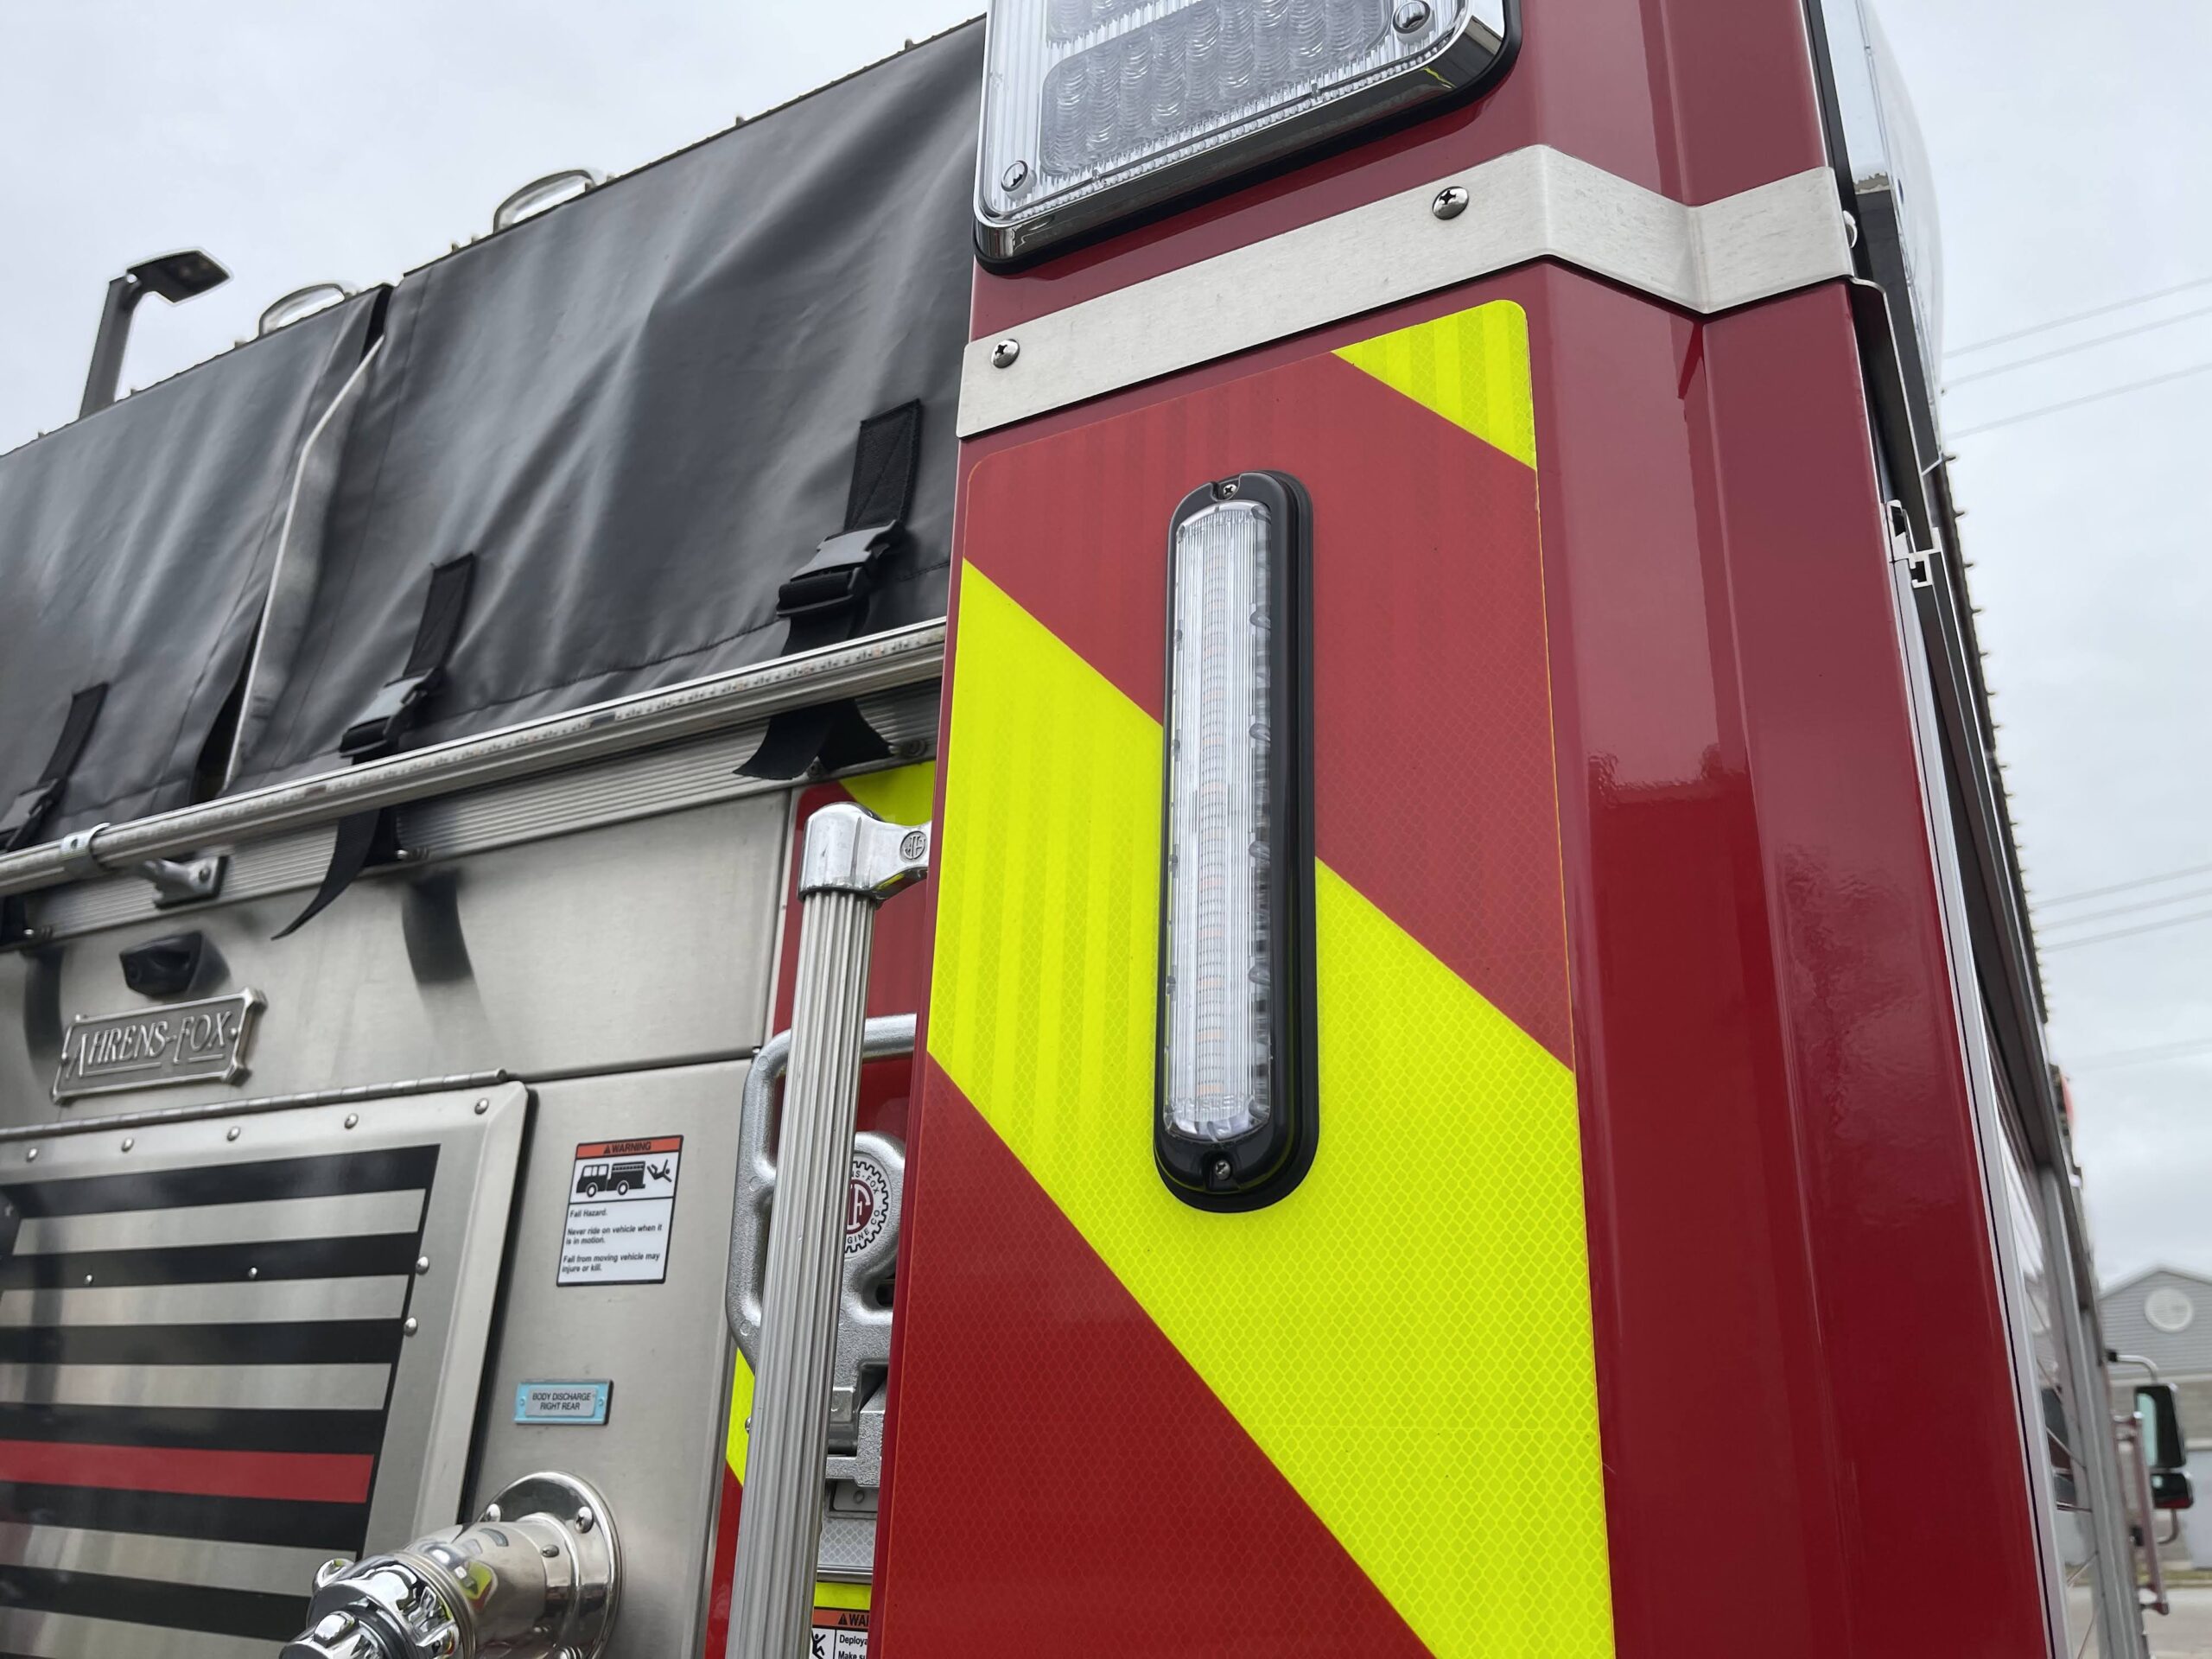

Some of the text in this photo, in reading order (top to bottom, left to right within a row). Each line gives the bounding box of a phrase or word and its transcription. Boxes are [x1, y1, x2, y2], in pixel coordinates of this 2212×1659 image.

[65, 1010, 232, 1079] AHRENS-FOX
[612, 1141, 652, 1153] WARNING
[594, 1254, 618, 1263] moving
[645, 1253, 660, 1262] may
[563, 1265, 581, 1274] injure
